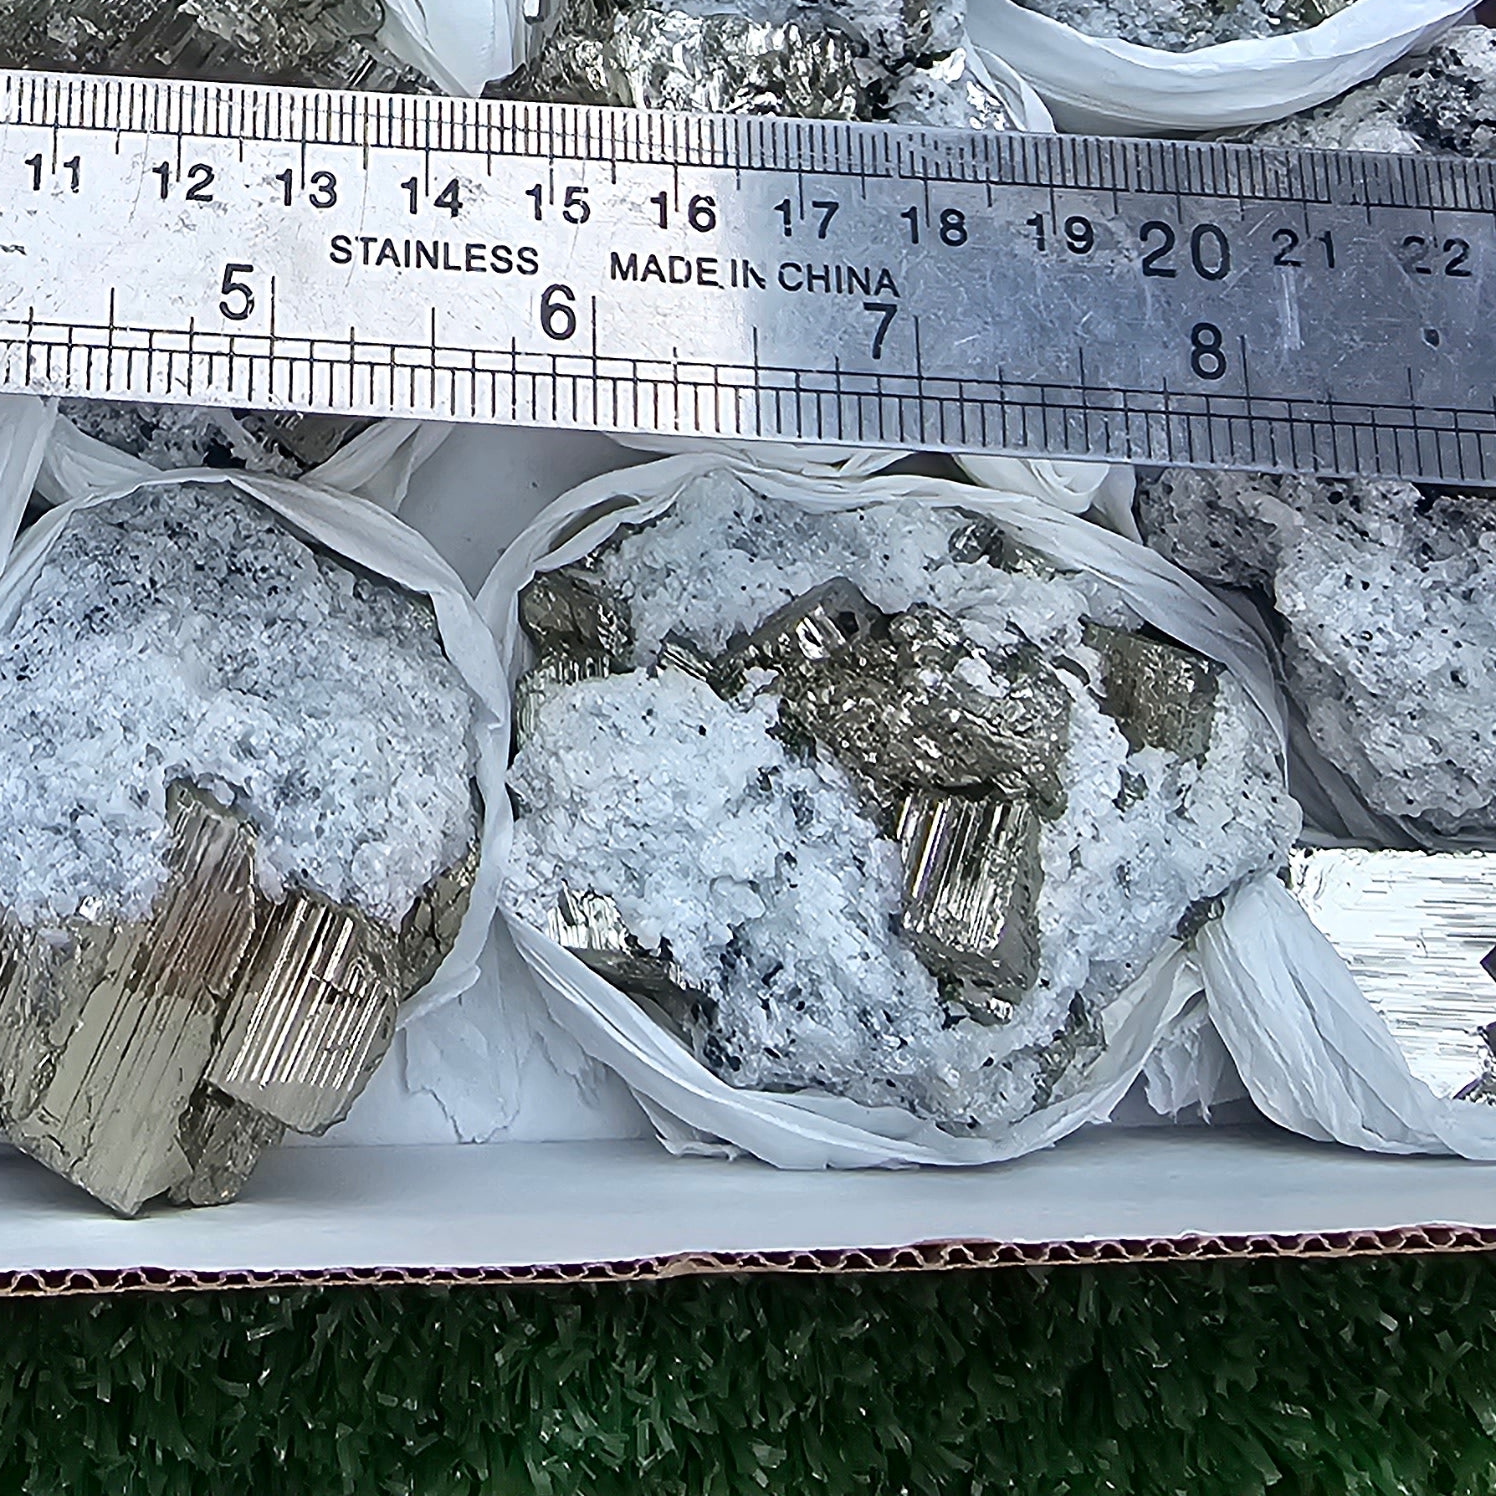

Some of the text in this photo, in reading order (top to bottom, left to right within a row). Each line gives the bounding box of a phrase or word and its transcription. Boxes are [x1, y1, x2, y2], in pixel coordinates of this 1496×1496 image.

[24, 153, 82, 194] 11
[152, 161, 215, 203] 12
[275, 168, 337, 209] 13
[400, 176, 464, 218] 14
[525, 183, 591, 224] 15
[650, 191, 717, 233] 16
[773, 198, 840, 240] 17
[900, 206, 968, 248] 18
[1026, 212, 1095, 255] 19
[1139, 219, 1232, 282] 20
[1271, 228, 1336, 269] 21
[1404, 235, 1472, 277] 22
[329, 235, 540, 276] STAINLESS
[610, 252, 901, 299] MADE IN CHINA
[219, 263, 255, 322] 5
[540, 284, 577, 341] 6
[862, 303, 899, 361] 7
[1190, 322, 1227, 381] 8
